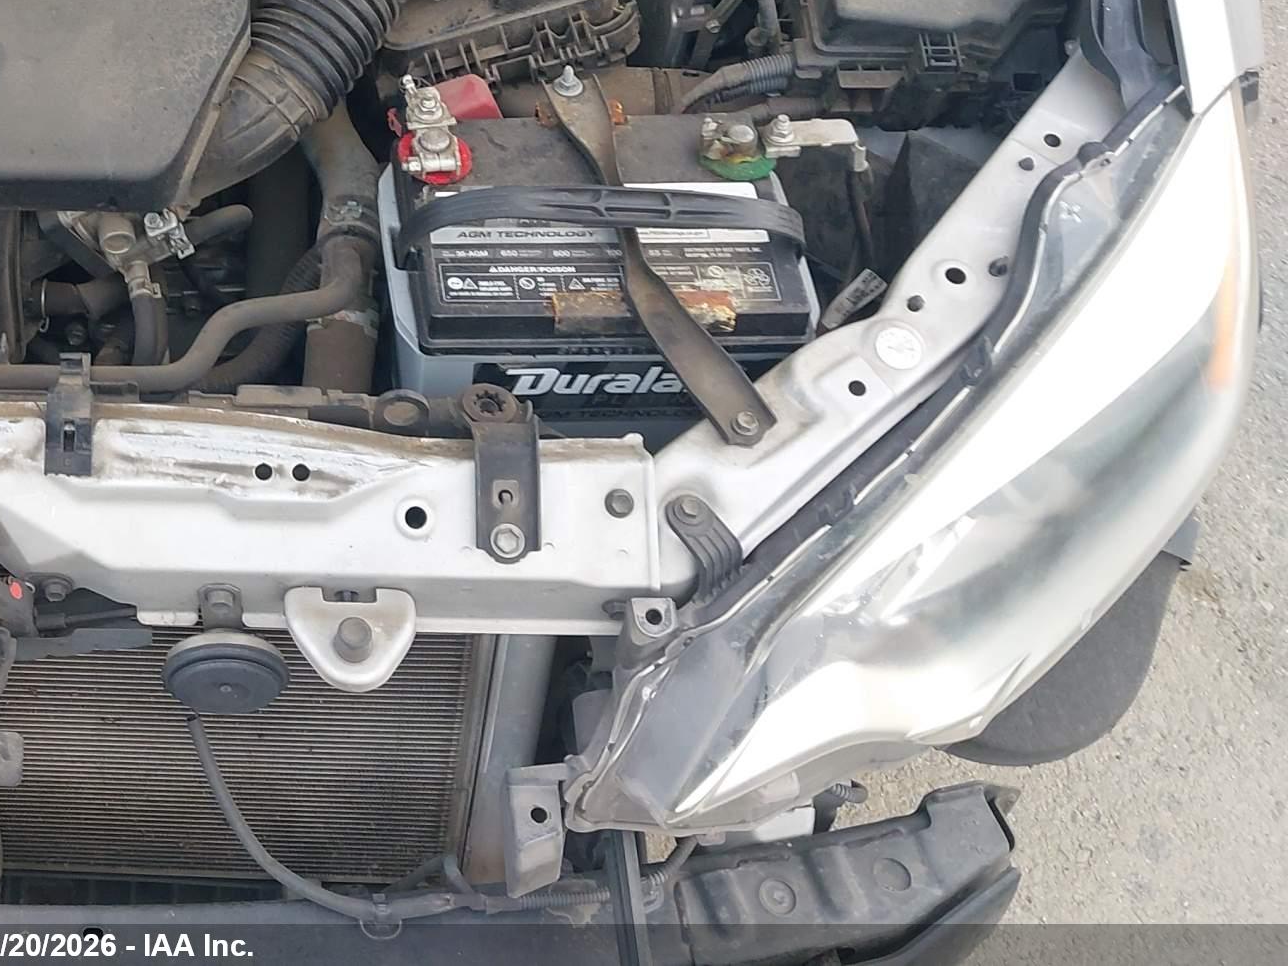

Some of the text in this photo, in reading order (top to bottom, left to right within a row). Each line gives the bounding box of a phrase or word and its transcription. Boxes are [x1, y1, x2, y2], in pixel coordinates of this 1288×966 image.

[456, 229, 594, 239] AGM TECHNOLOGY
[505, 366, 688, 396] Durala
